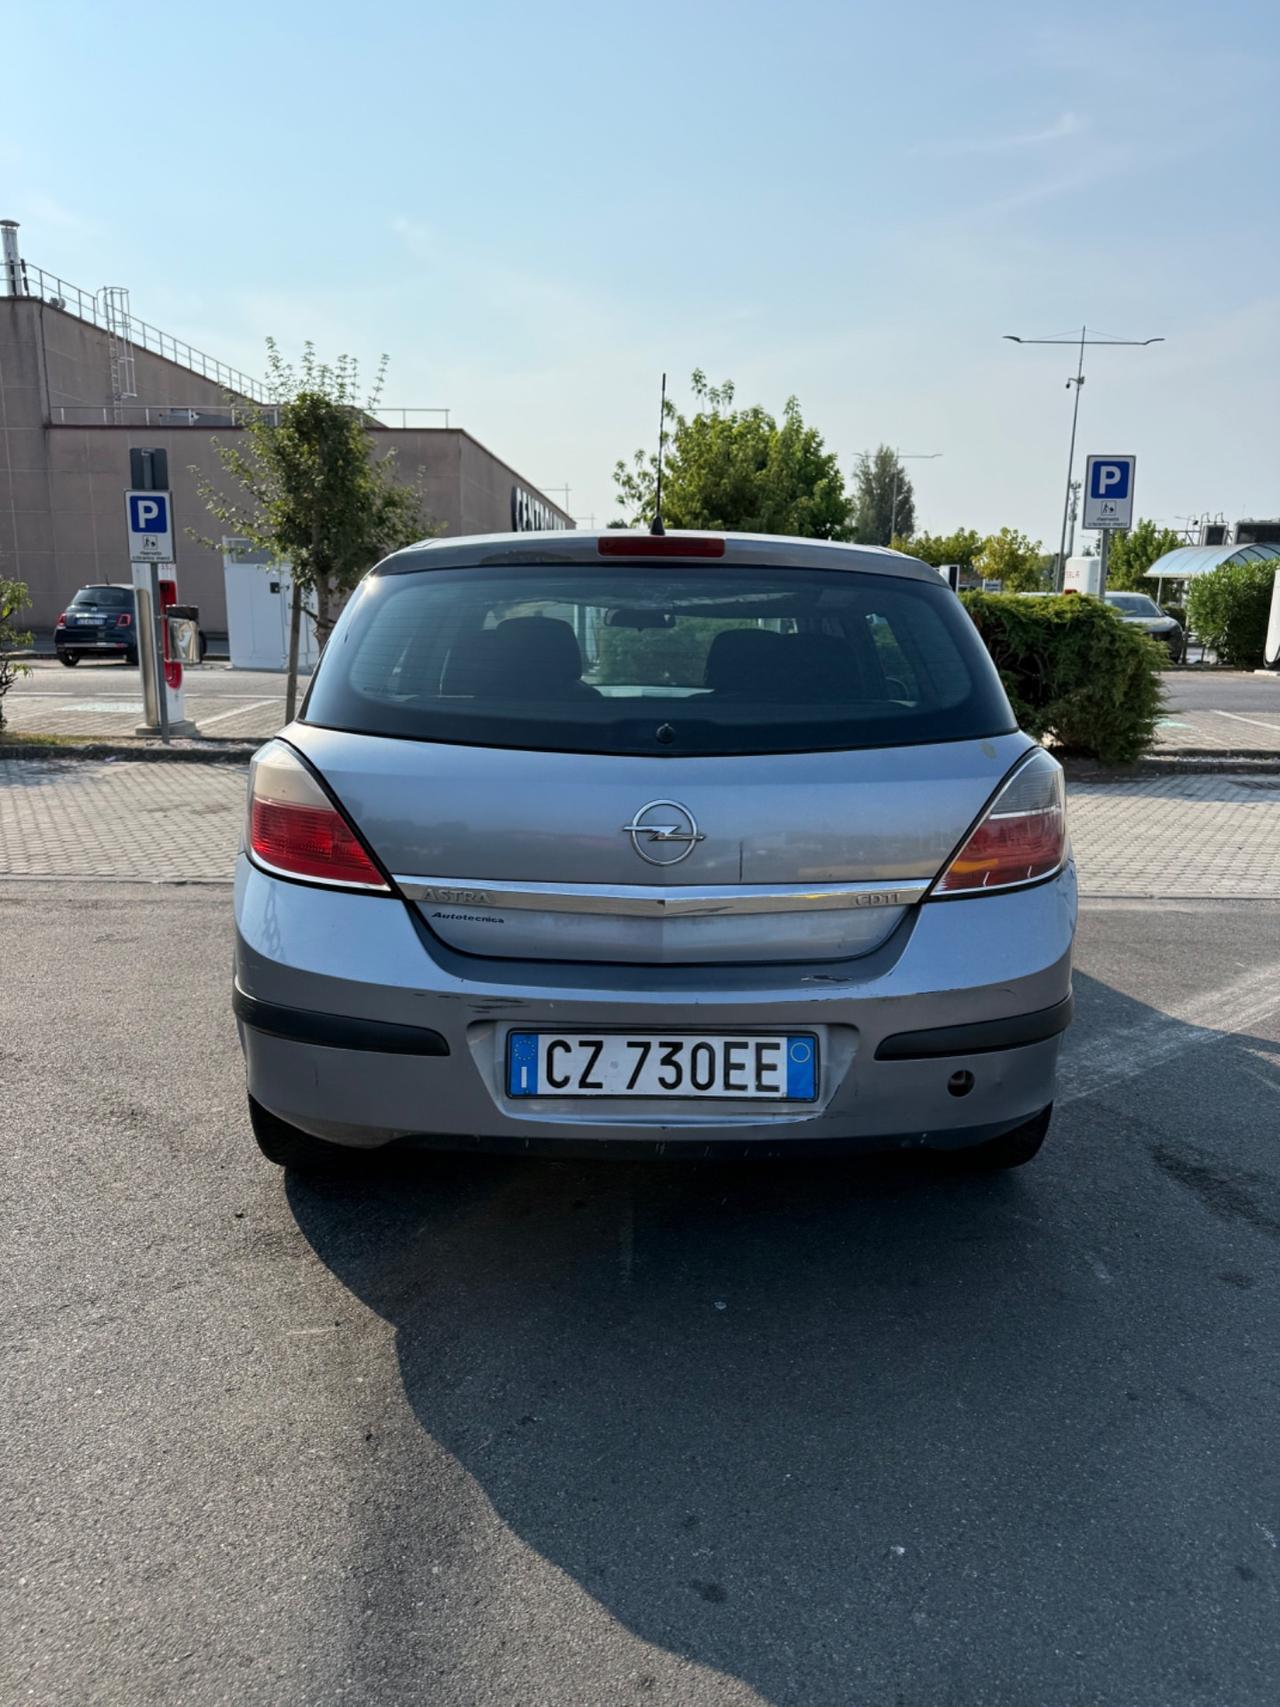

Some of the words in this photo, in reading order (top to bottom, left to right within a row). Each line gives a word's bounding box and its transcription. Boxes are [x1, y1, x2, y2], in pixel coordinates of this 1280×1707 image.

[1098, 465, 1121, 495] P
[137, 500, 159, 528] P
[424, 888, 491, 904] ASTRA
[856, 892, 900, 906] CDTI
[431, 911, 504, 924] Autotecnica
[546, 1039, 604, 1089] CZ
